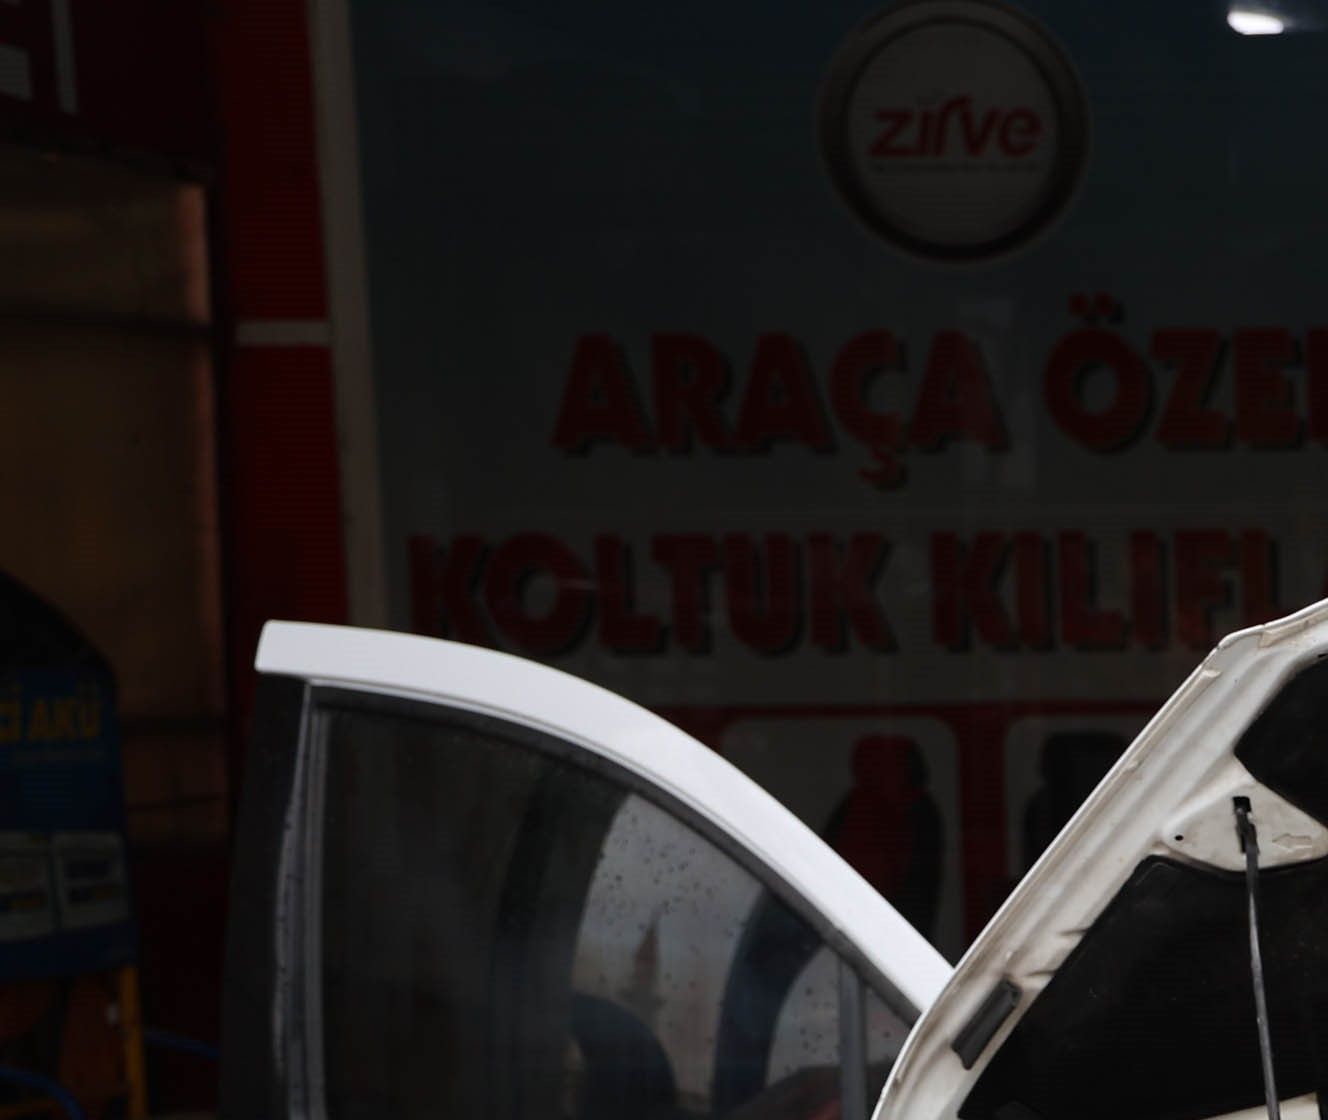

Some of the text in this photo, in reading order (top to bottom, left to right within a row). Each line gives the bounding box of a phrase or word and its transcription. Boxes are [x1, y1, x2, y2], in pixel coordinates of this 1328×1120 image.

[867, 93, 1044, 157] zirve
[553, 329, 1006, 486] ARAÇA
[408, 531, 895, 658] KOLTUK
